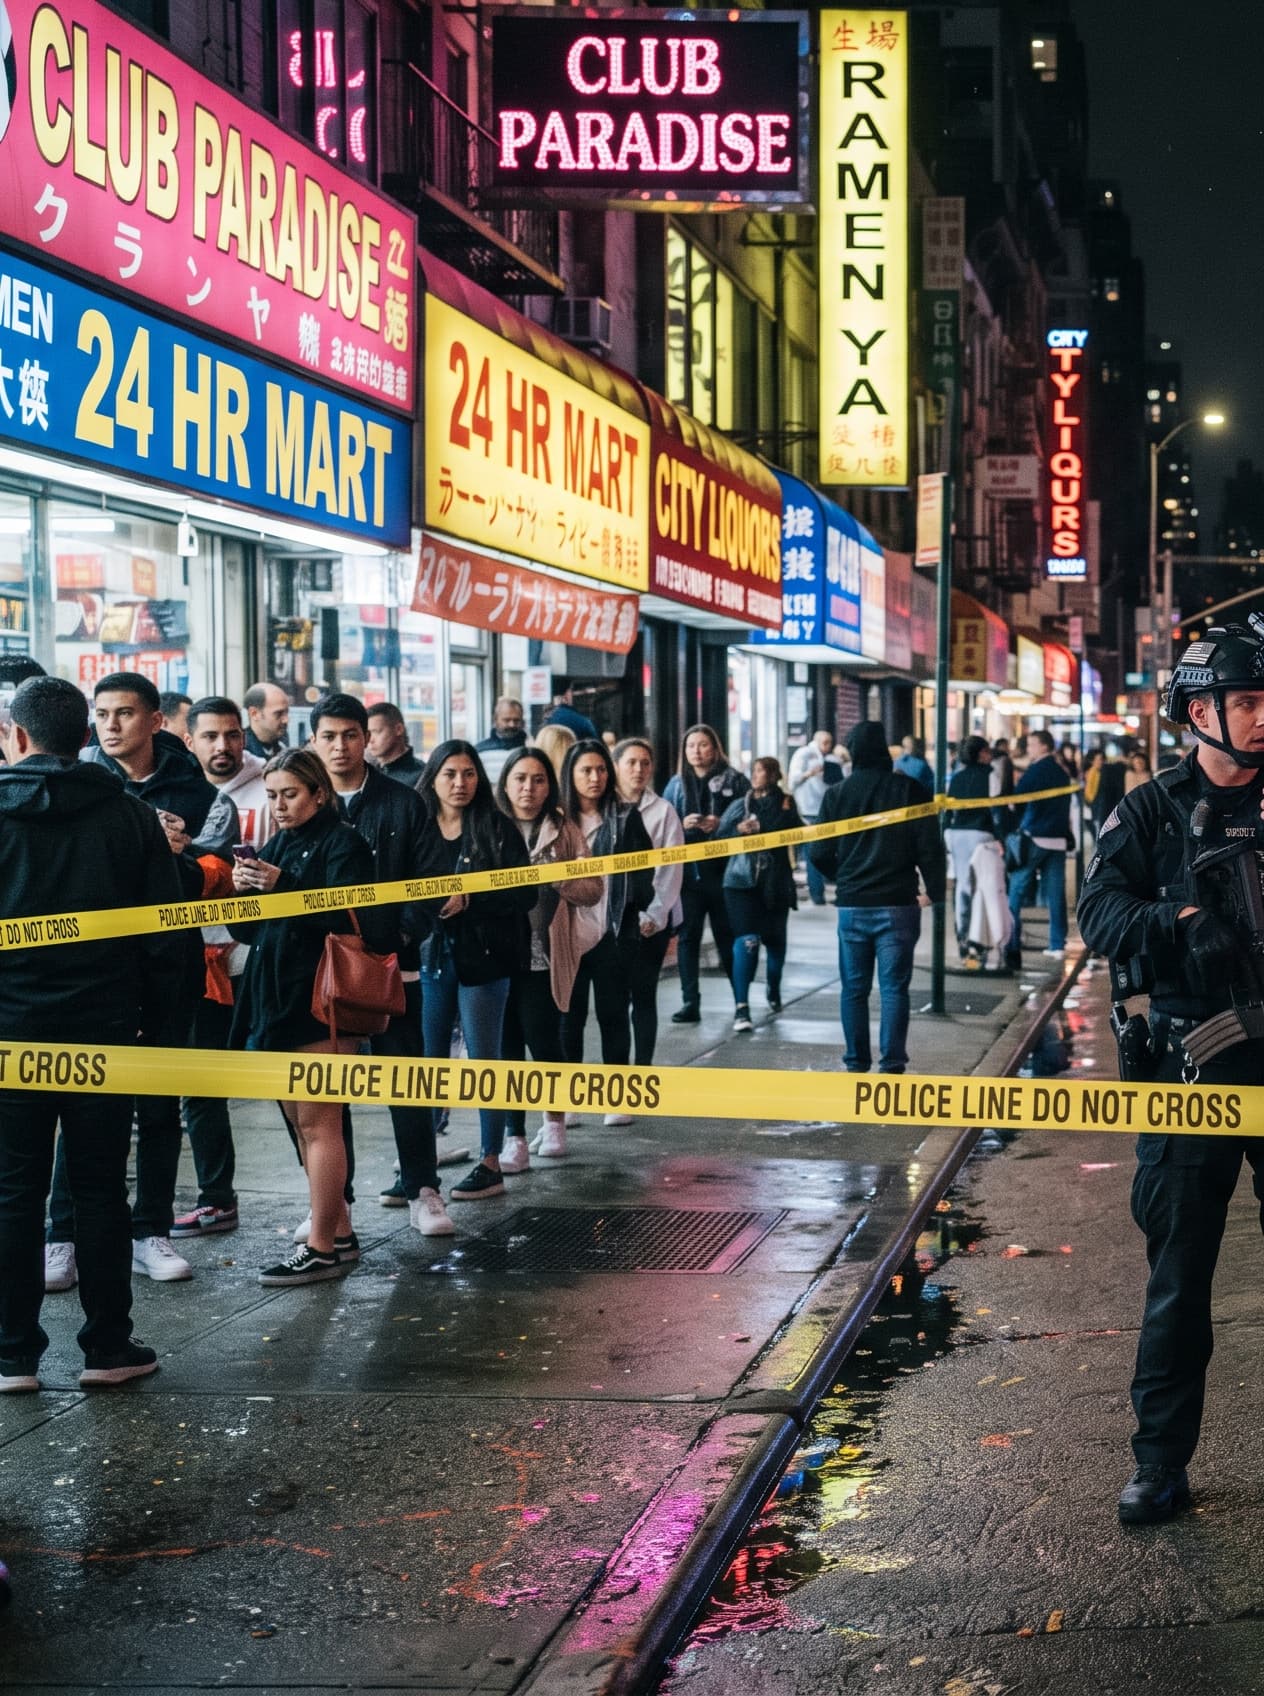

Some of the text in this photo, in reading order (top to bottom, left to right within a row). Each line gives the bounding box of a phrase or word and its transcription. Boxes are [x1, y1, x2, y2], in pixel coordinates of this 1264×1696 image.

[567, 36, 722, 96] CLUB
[28, 3, 180, 223] CLUB
[193, 101, 381, 334] PARADISE
[499, 111, 792, 174] PARADISE
[838, 61, 889, 300] RAMEN
[1047, 329, 1089, 348] CITY
[837, 329, 889, 415] YA
[75, 309, 154, 458] 24
[173, 343, 251, 489] HR
[266, 381, 393, 528] MART
[448, 341, 493, 459] 24
[506, 369, 552, 485] HR
[564, 401, 639, 518] MART
[655, 452, 706, 552] CITY
[709, 479, 782, 584] LIQUORS
[6, 917, 80, 945] DO NOT CROSS
[19, 1051, 107, 1087] CROSS
[289, 1061, 661, 1109] POLICE LINE DO NOT CROSS
[856, 1081, 1242, 1129] POLICE LINE DO NOT CROSS
